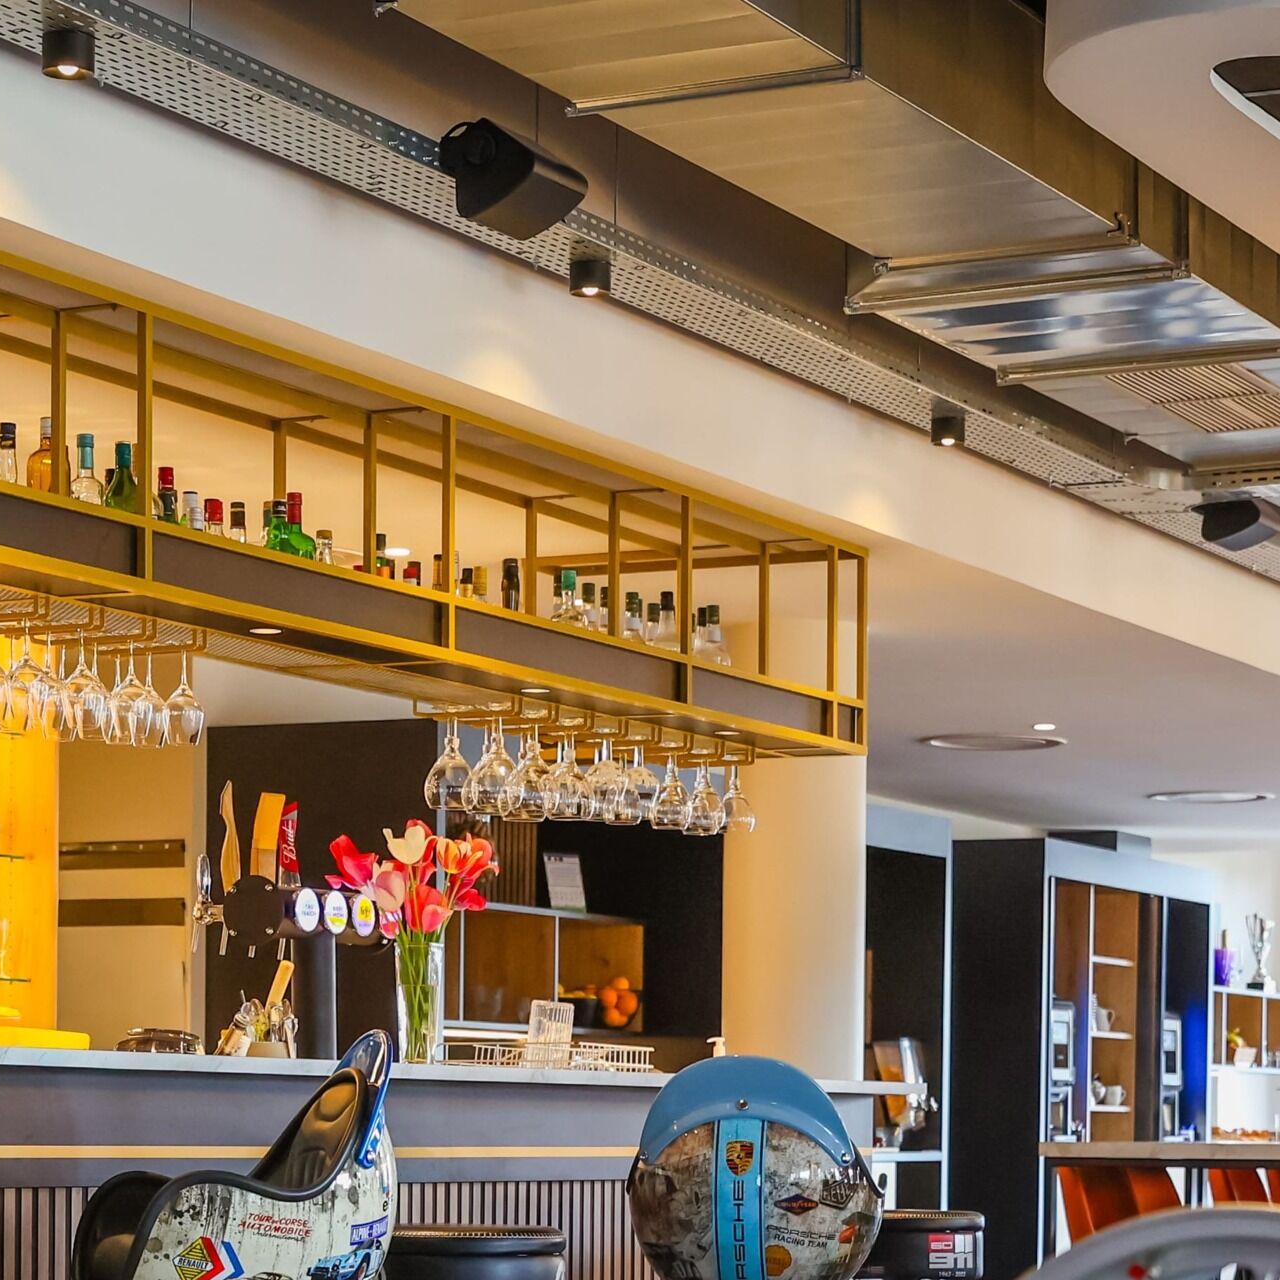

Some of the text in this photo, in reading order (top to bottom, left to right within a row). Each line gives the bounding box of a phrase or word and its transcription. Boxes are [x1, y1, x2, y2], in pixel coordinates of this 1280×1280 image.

[248, 1213, 272, 1224] TOUR
[280, 1217, 309, 1227] CORSE
[239, 1220, 313, 1238] AUTOMOBILE
[767, 1224, 836, 1240] PORSCHE
[774, 1234, 828, 1249] RACING TEAM
[177, 1256, 211, 1270] RENAULT
